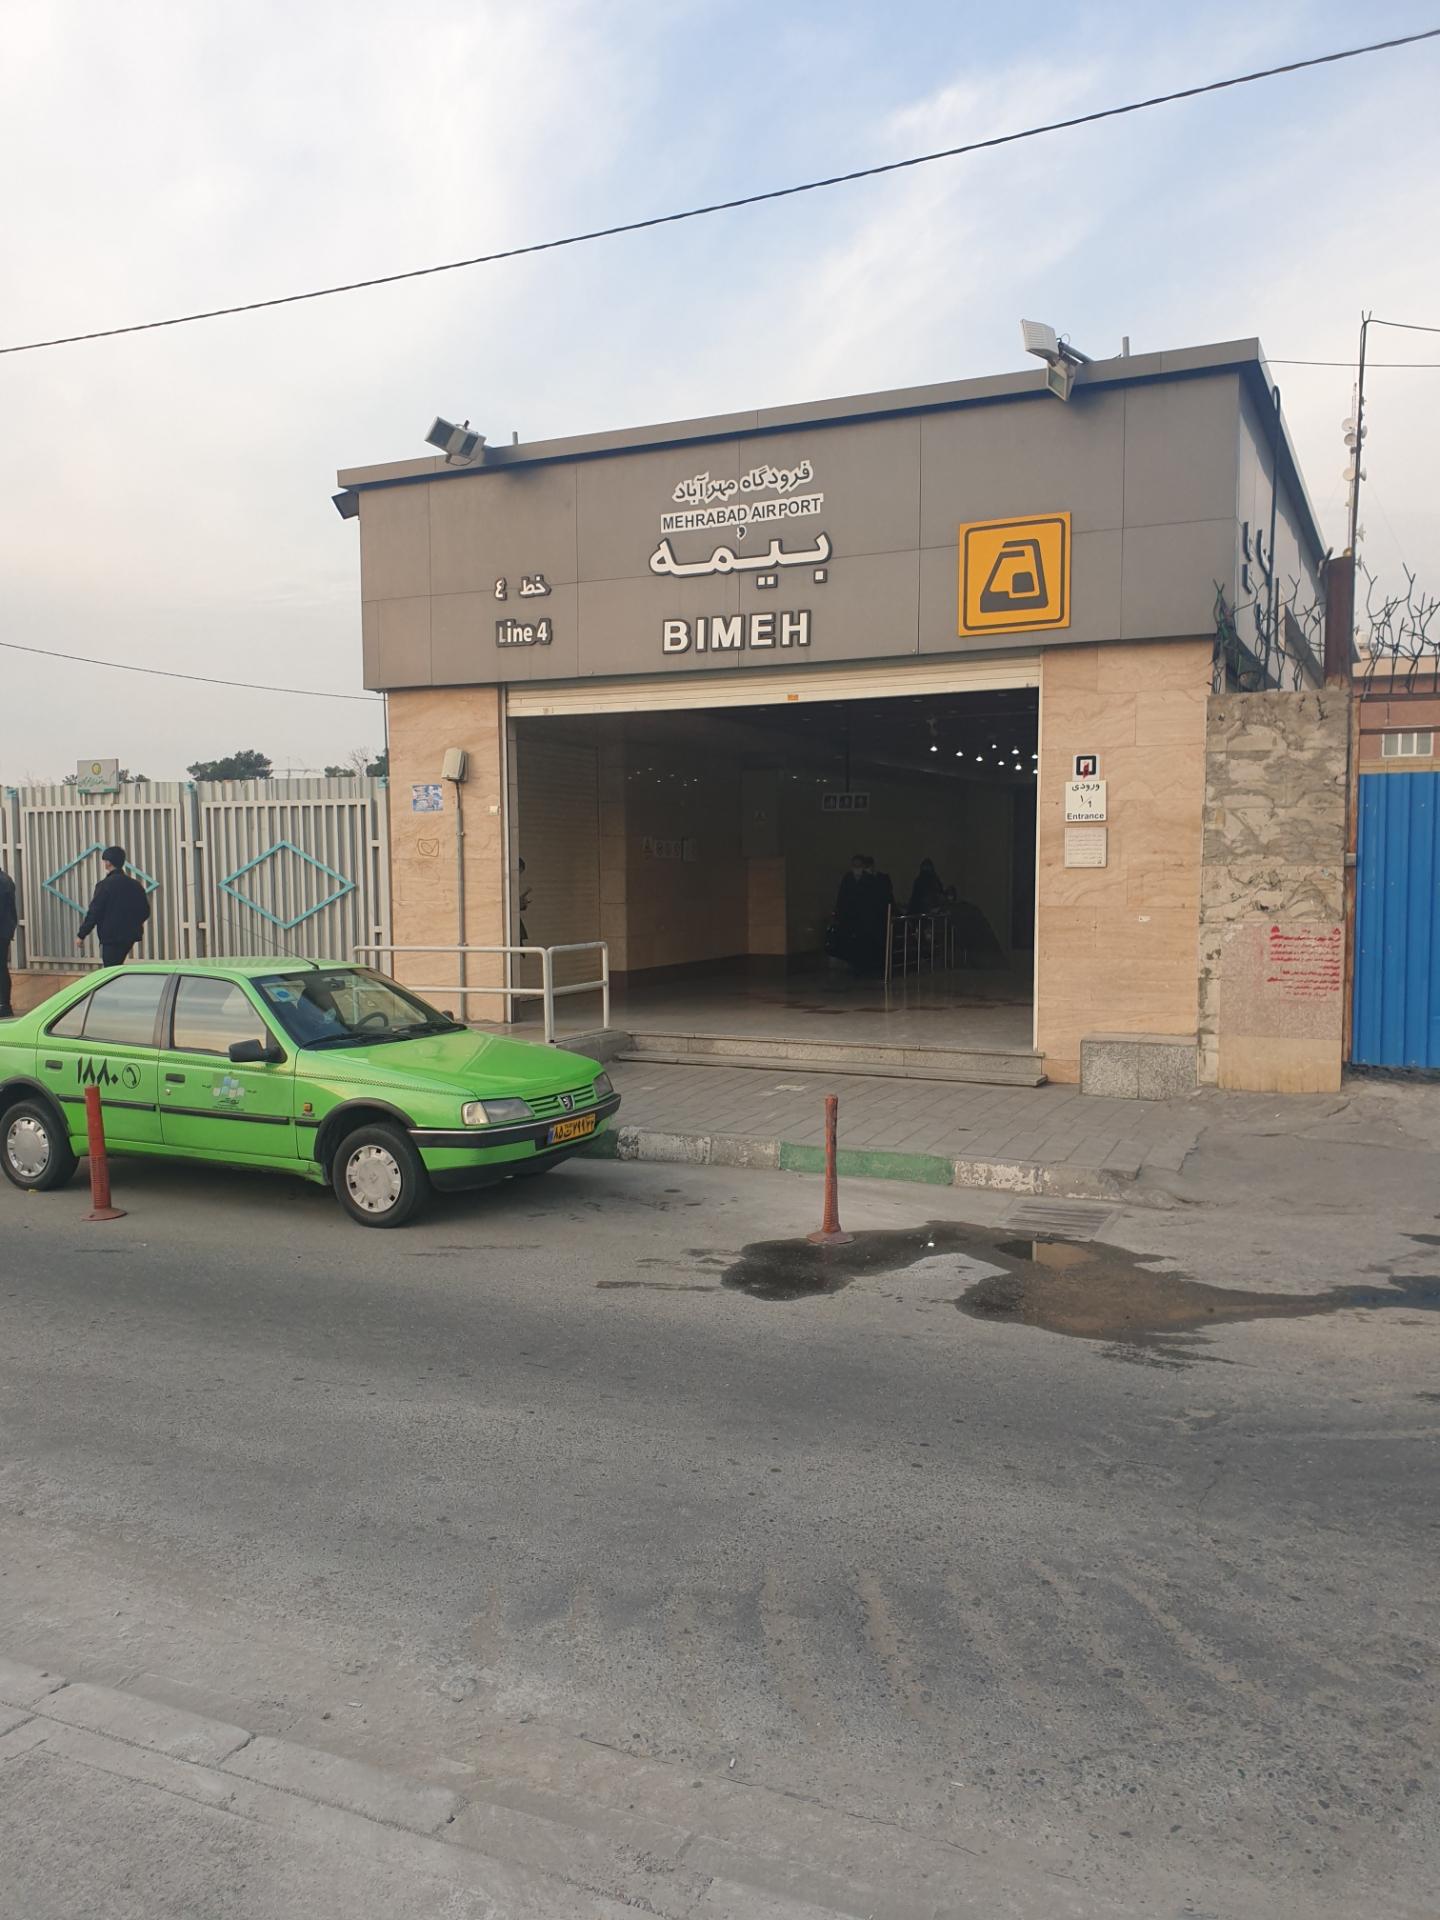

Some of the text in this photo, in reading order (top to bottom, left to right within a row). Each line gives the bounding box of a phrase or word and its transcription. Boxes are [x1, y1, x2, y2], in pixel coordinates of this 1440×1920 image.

[674, 462, 811, 503] فرودگاه مهرآباد
[662, 497, 822, 531] MEHRABAD AIRPORT
[650, 533, 830, 588] بیمه
[520, 575, 548, 597] خط
[498, 621, 549, 643] Line 4
[663, 611, 809, 653] BIMEH
[1071, 783, 1100, 792] ورودی
[77, 1056, 119, 1087] ۱۸۸۰
